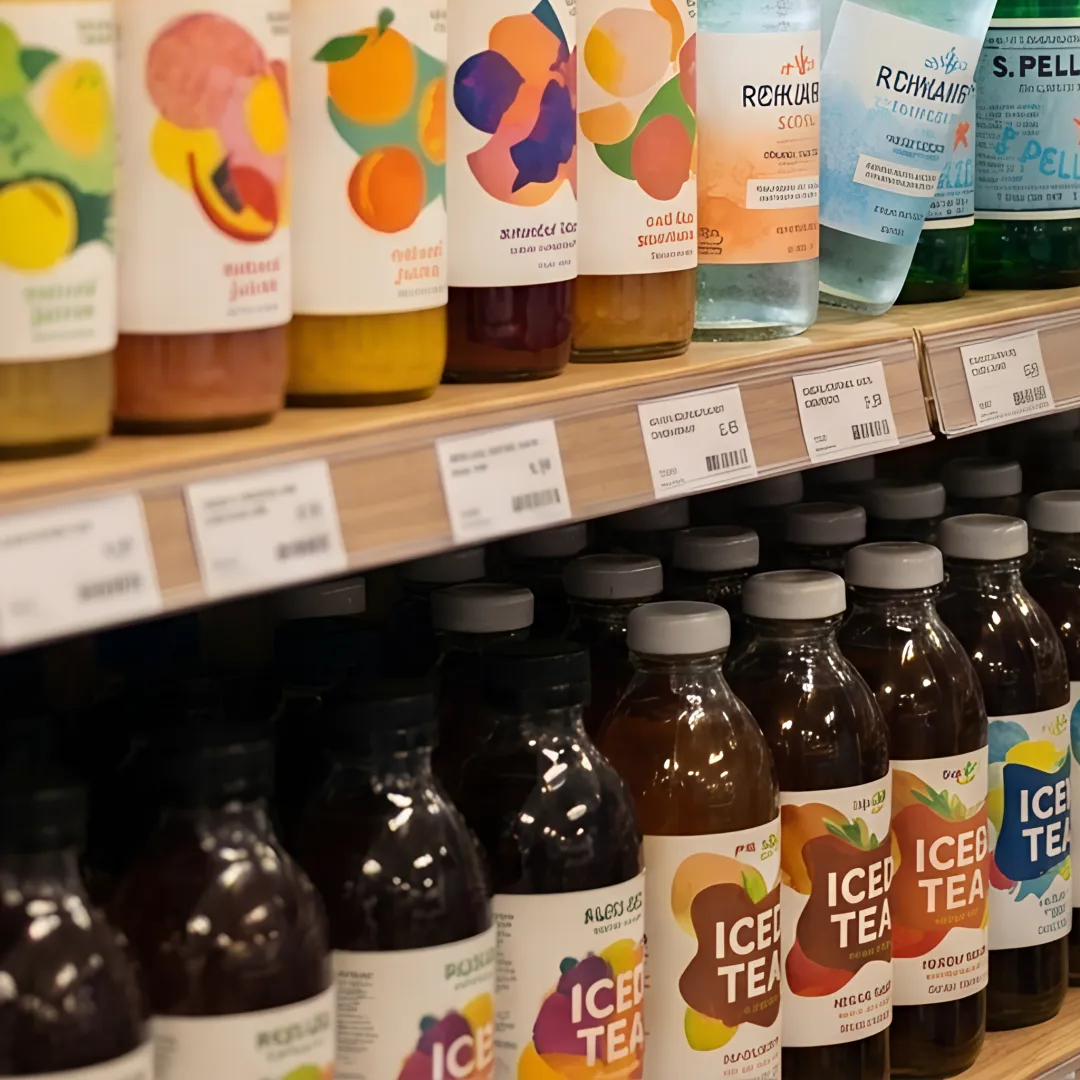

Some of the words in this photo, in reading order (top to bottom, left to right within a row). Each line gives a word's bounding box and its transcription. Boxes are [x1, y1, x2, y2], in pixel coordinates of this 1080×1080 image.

[918, 868, 984, 913] TEA
[830, 897, 892, 949] TEA
[576, 1010, 645, 1068] TEA
